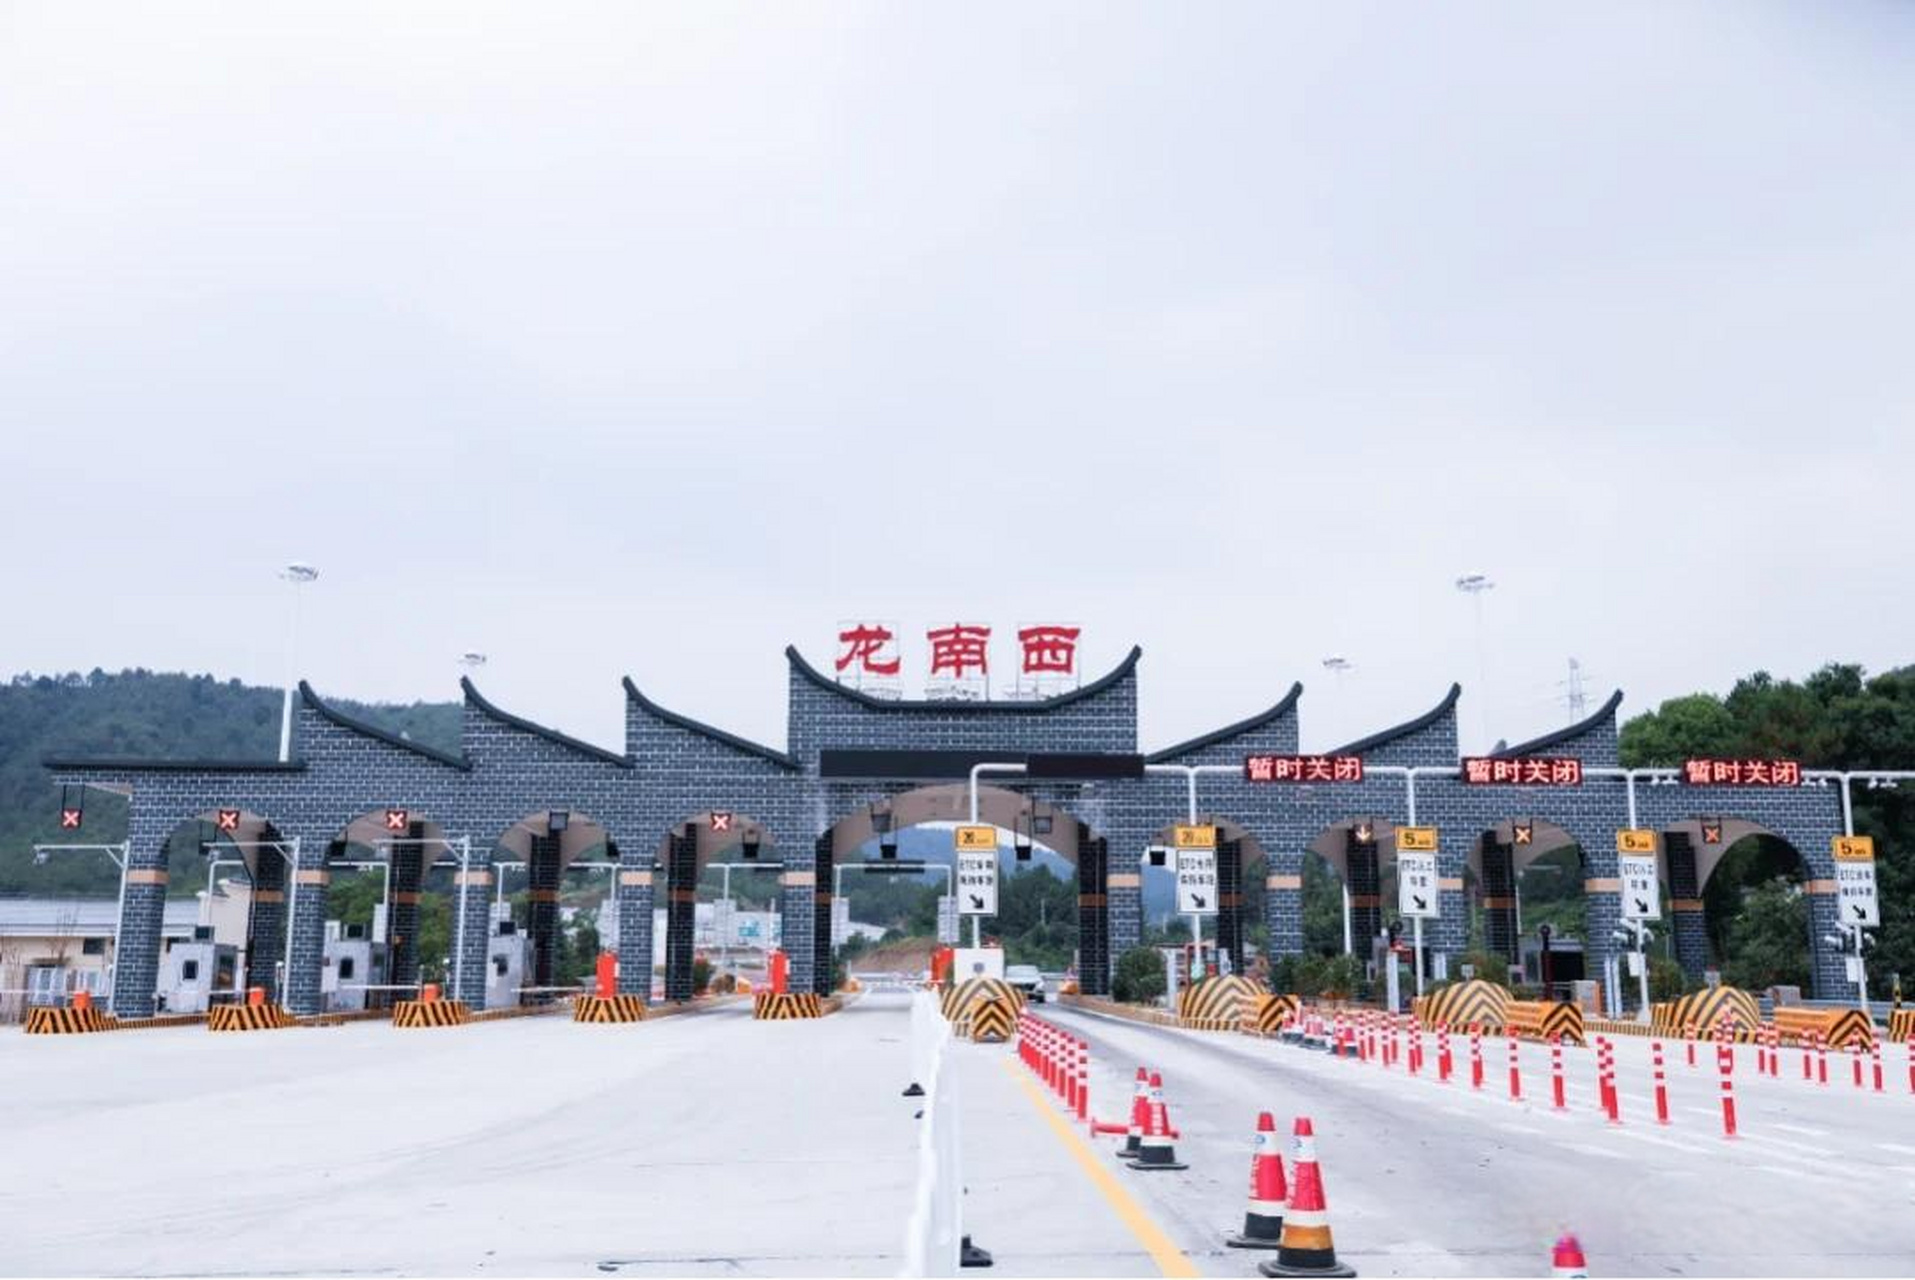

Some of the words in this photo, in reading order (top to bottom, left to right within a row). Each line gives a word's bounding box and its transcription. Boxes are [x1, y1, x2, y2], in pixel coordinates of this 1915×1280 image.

[836, 623, 1081, 678] 龙南西
[1248, 757, 1361, 780] 暂时关闭
[1466, 760, 1579, 783] 暂时关闭
[1686, 760, 1799, 785] 暂时关闭
